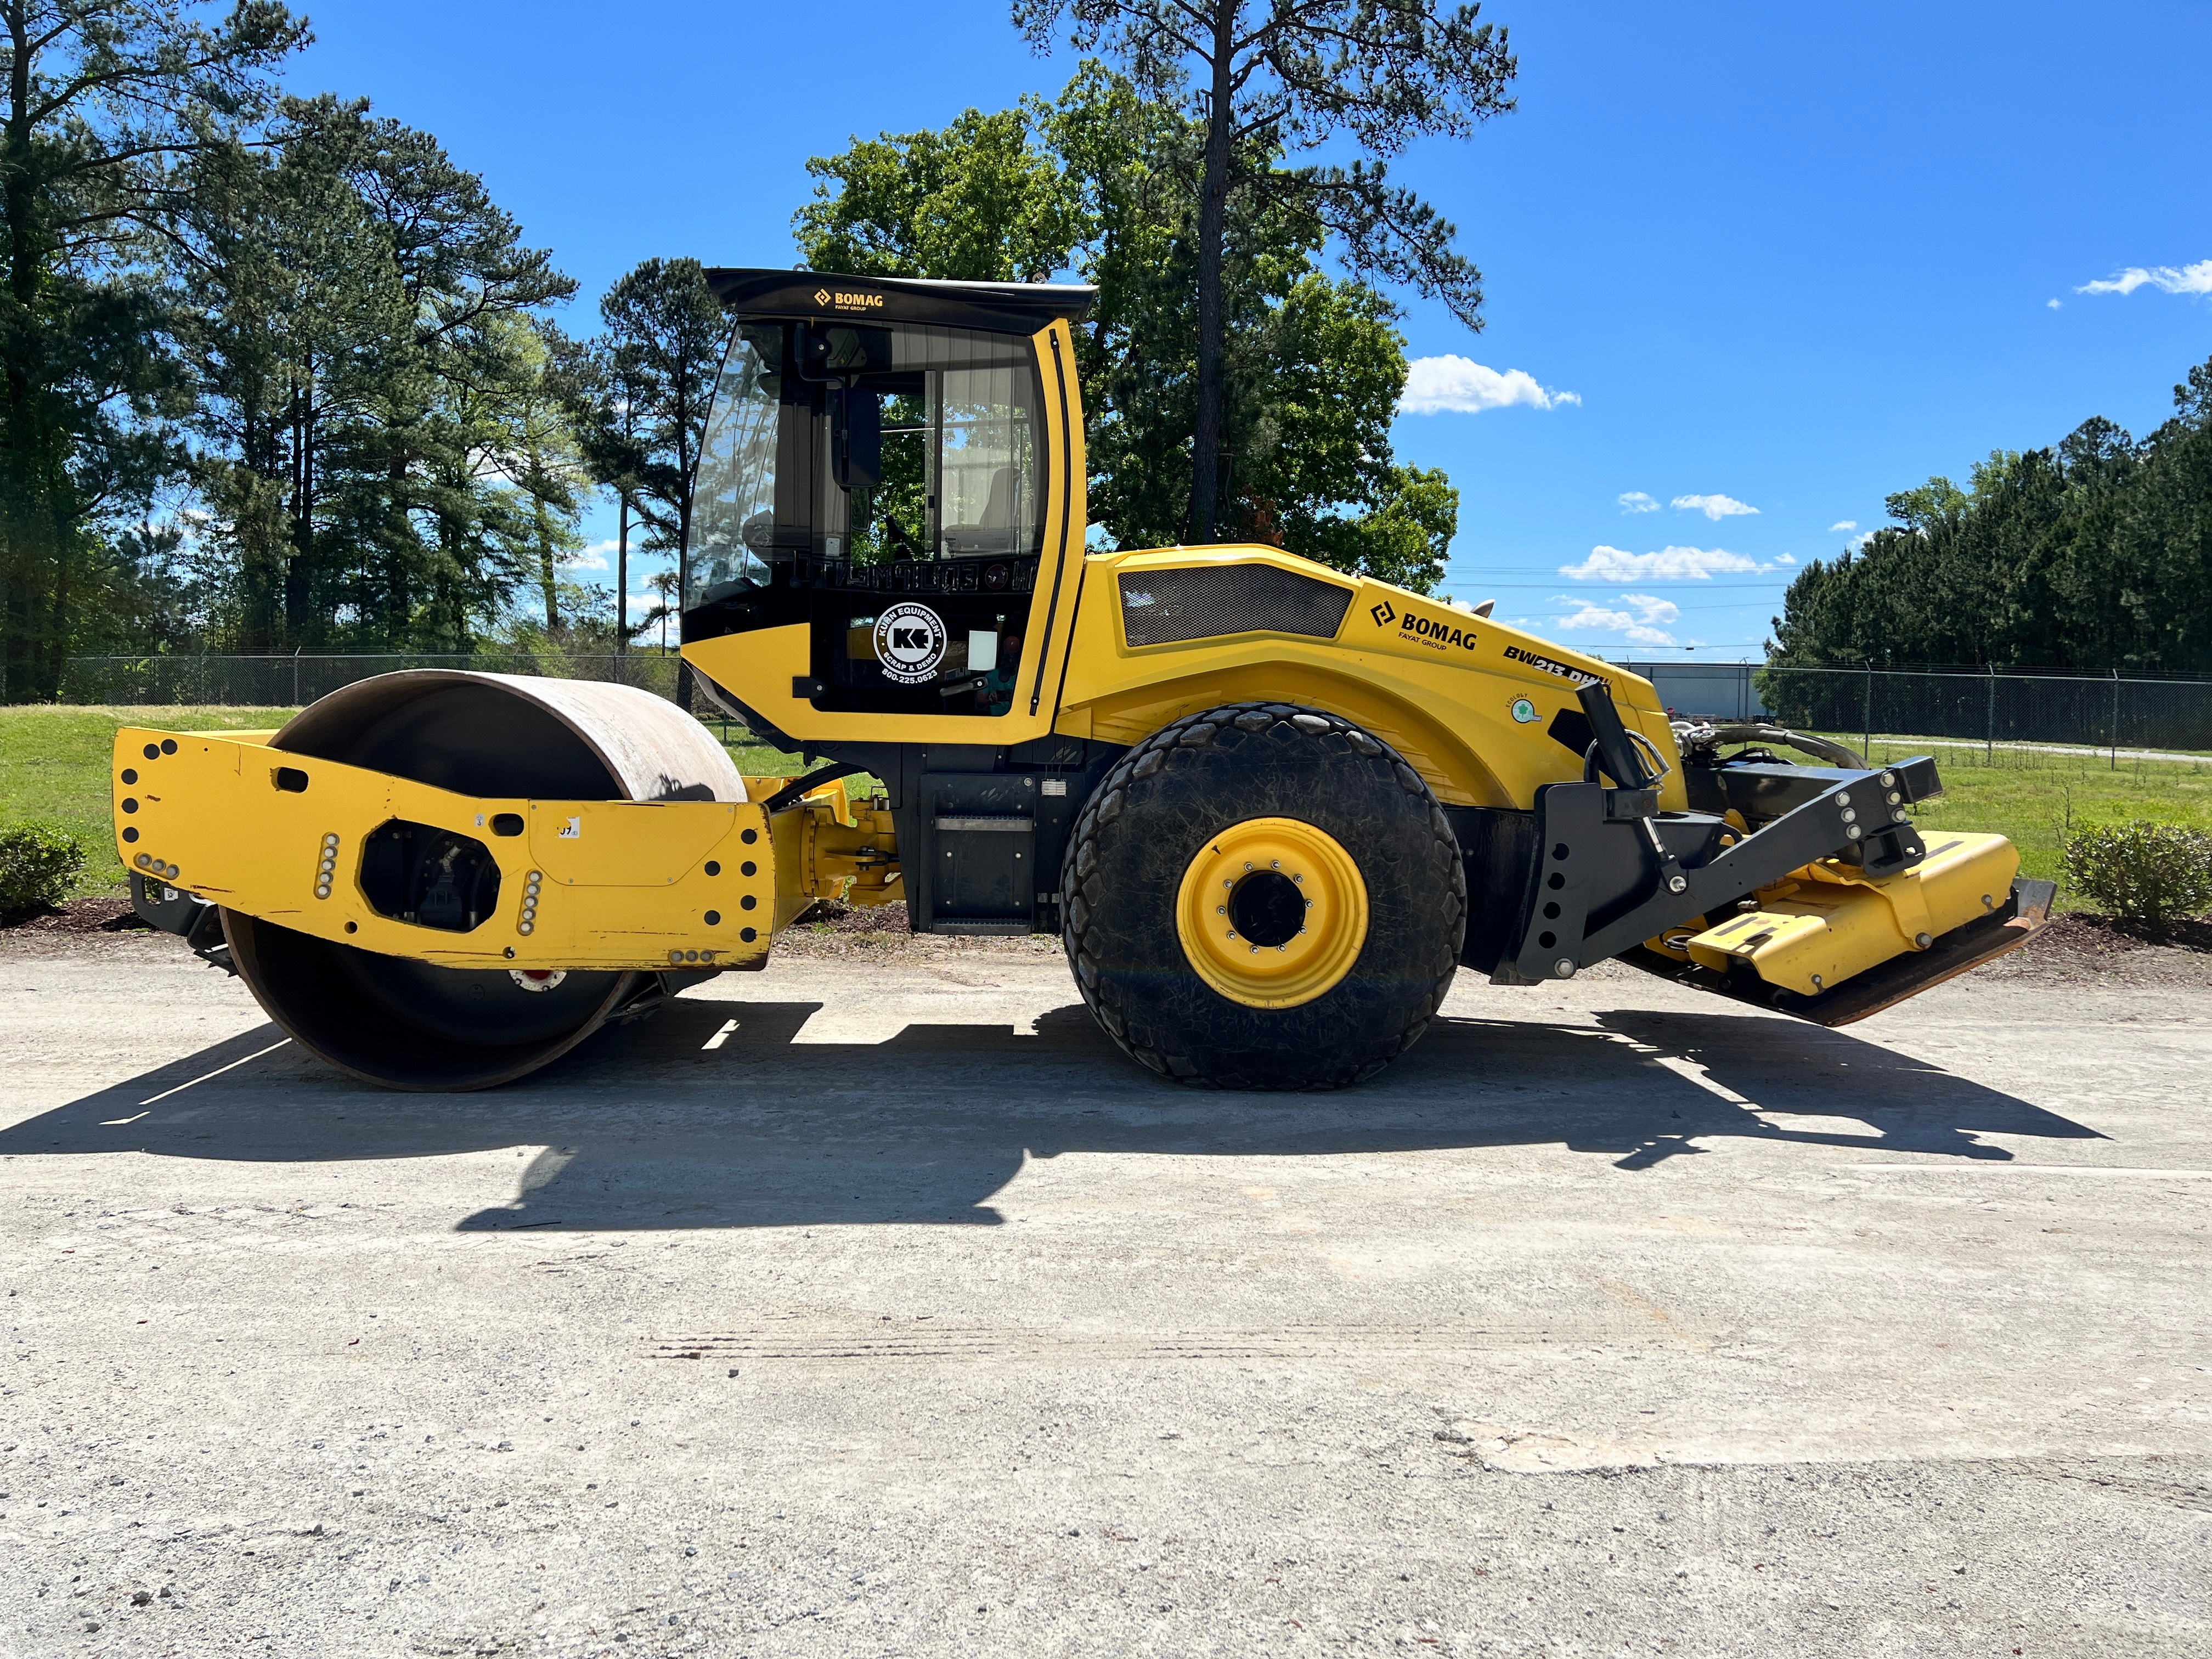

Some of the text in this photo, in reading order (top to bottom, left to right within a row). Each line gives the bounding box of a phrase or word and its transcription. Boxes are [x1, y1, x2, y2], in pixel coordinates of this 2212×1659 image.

[834, 292, 883, 307] BOMAG
[898, 607, 942, 638] EQUIPMENT
[1398, 631, 1447, 651] FAYAT GROUP
[1401, 613, 1477, 651] BOMAG
[883, 652, 907, 670] SCRAP
[916, 653, 937, 670] DEMO
[882, 668, 938, 684] 800.225.0623
[1505, 692, 1528, 708] ECOLOGY
